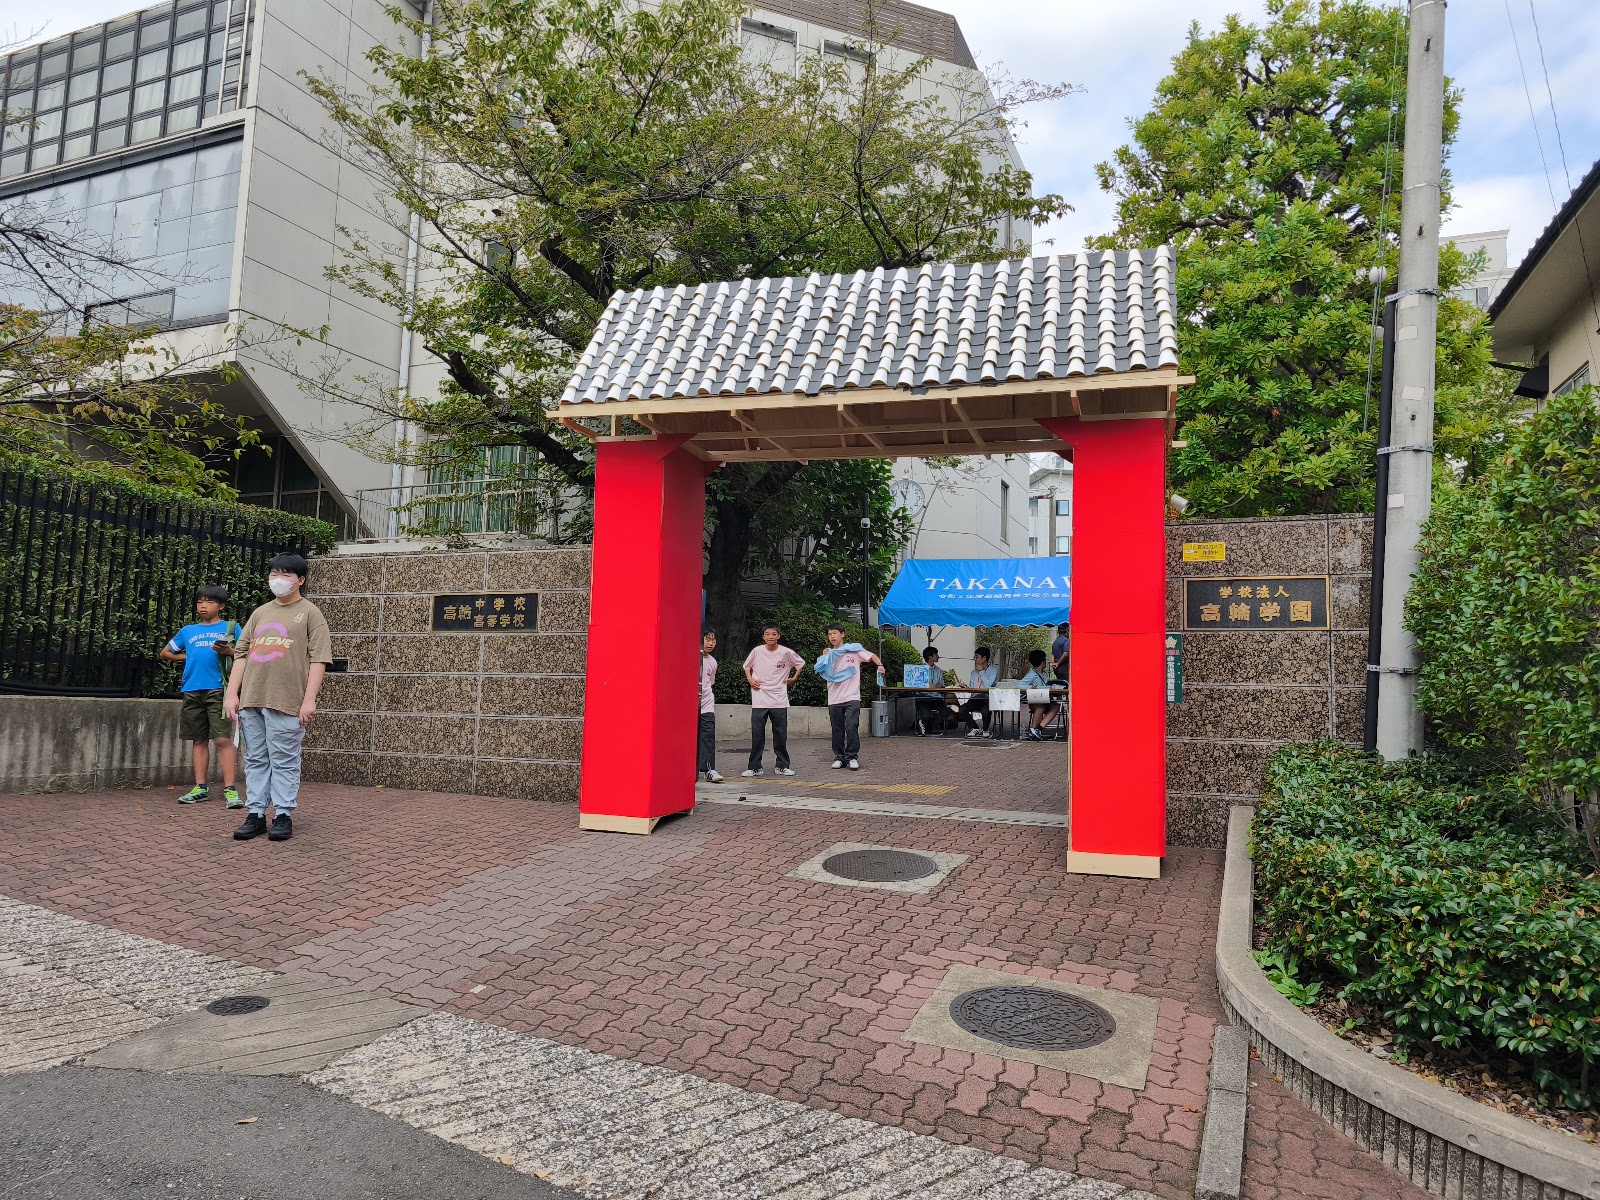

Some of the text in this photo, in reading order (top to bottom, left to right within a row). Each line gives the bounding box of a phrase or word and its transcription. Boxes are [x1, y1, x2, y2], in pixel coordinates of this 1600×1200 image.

[1219, 585, 1290, 599] 学校法人
[475, 596, 527, 611] 中学校
[443, 604, 472, 621] 高輪
[1199, 600, 1312, 623] 高輪学園
[473, 613, 525, 628] 高等学校
